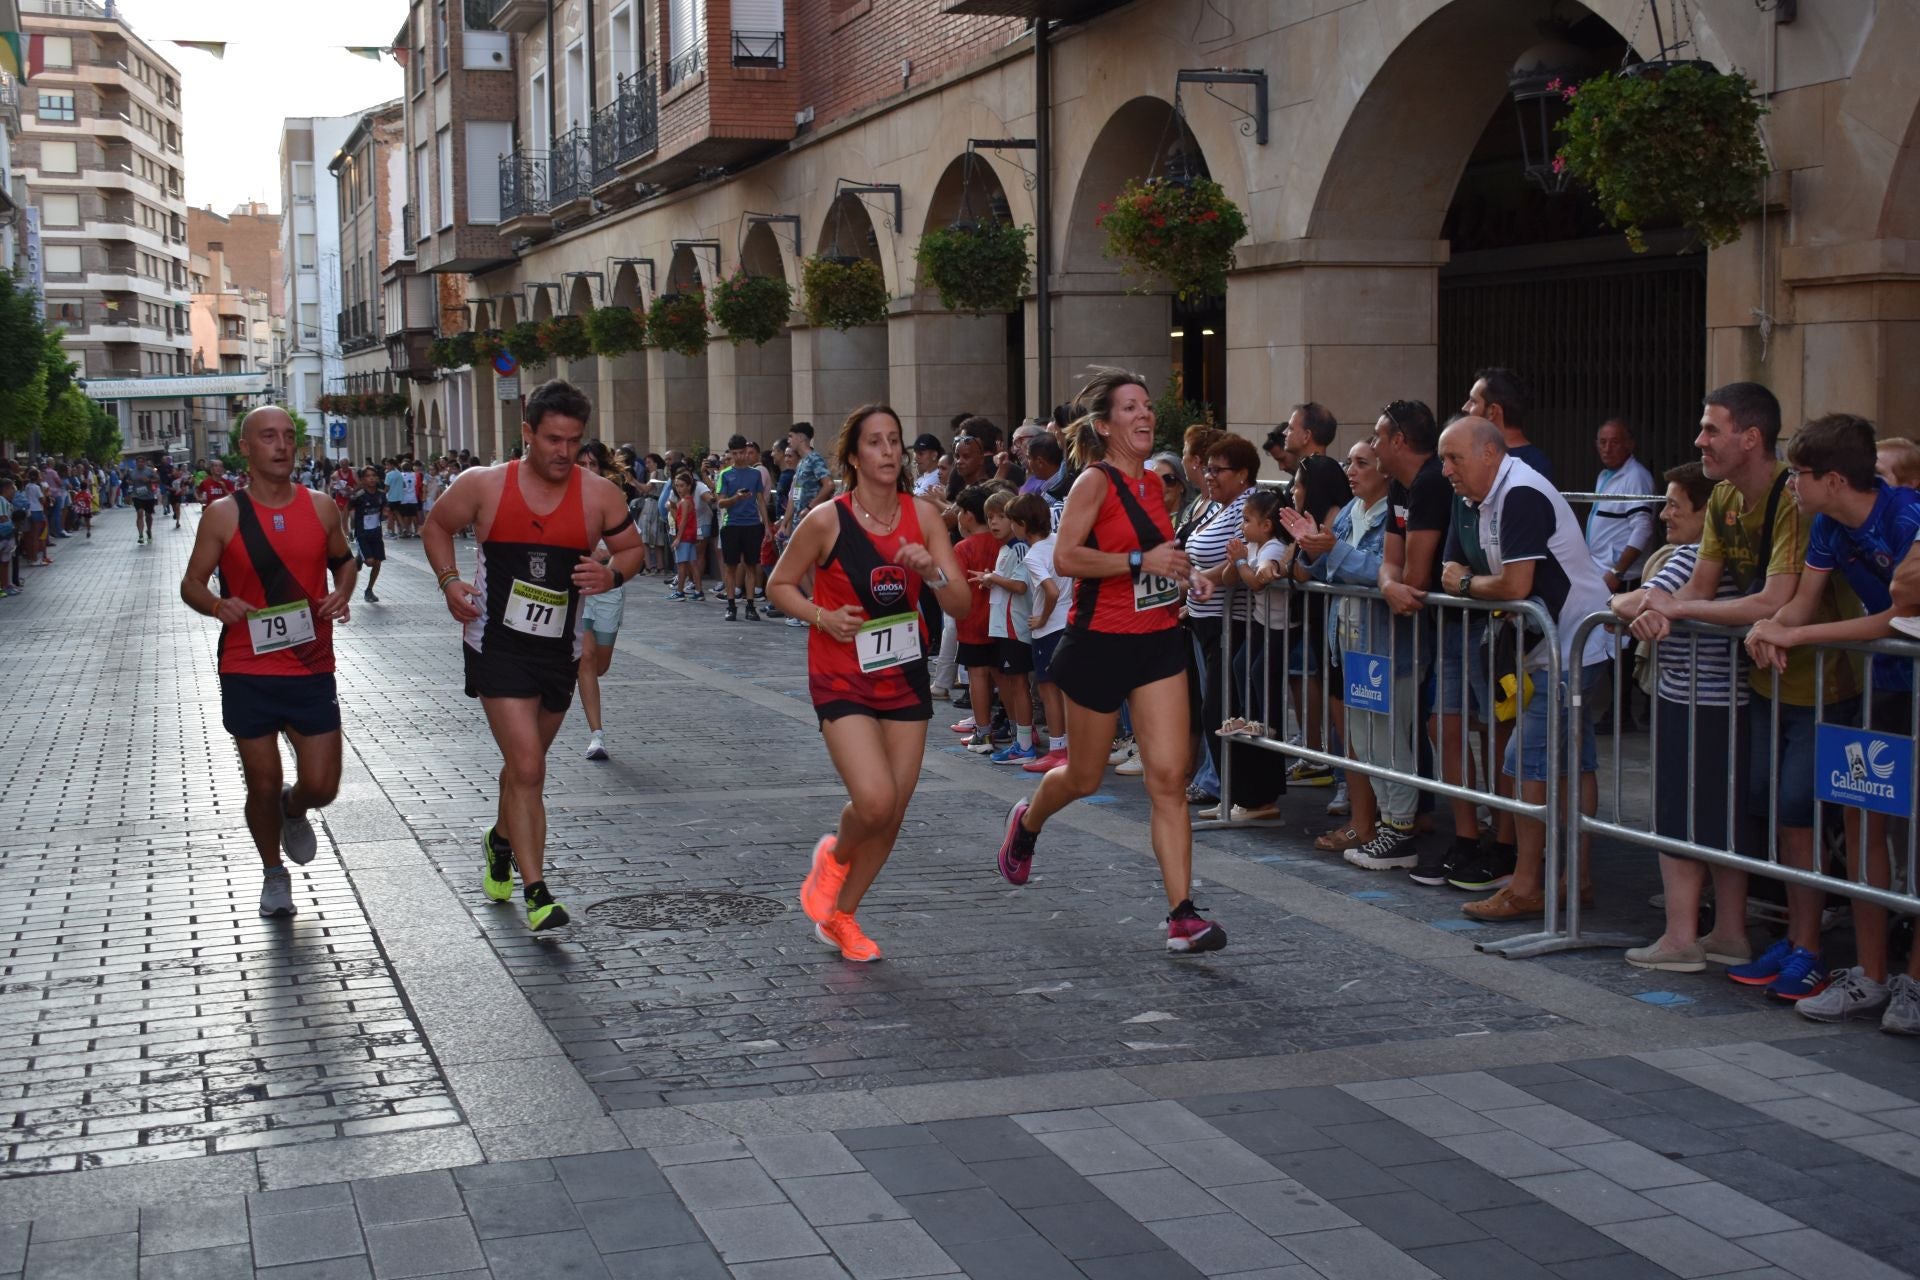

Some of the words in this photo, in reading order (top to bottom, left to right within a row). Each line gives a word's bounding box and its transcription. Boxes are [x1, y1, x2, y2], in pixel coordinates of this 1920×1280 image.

[873, 583, 904, 592] LODOSA
[526, 602, 554, 625] 171
[261, 616, 287, 638] 79
[871, 627, 892, 654] 77
[1350, 683, 1382, 701] Calahorra
[1831, 770, 1895, 799] Calahorra
